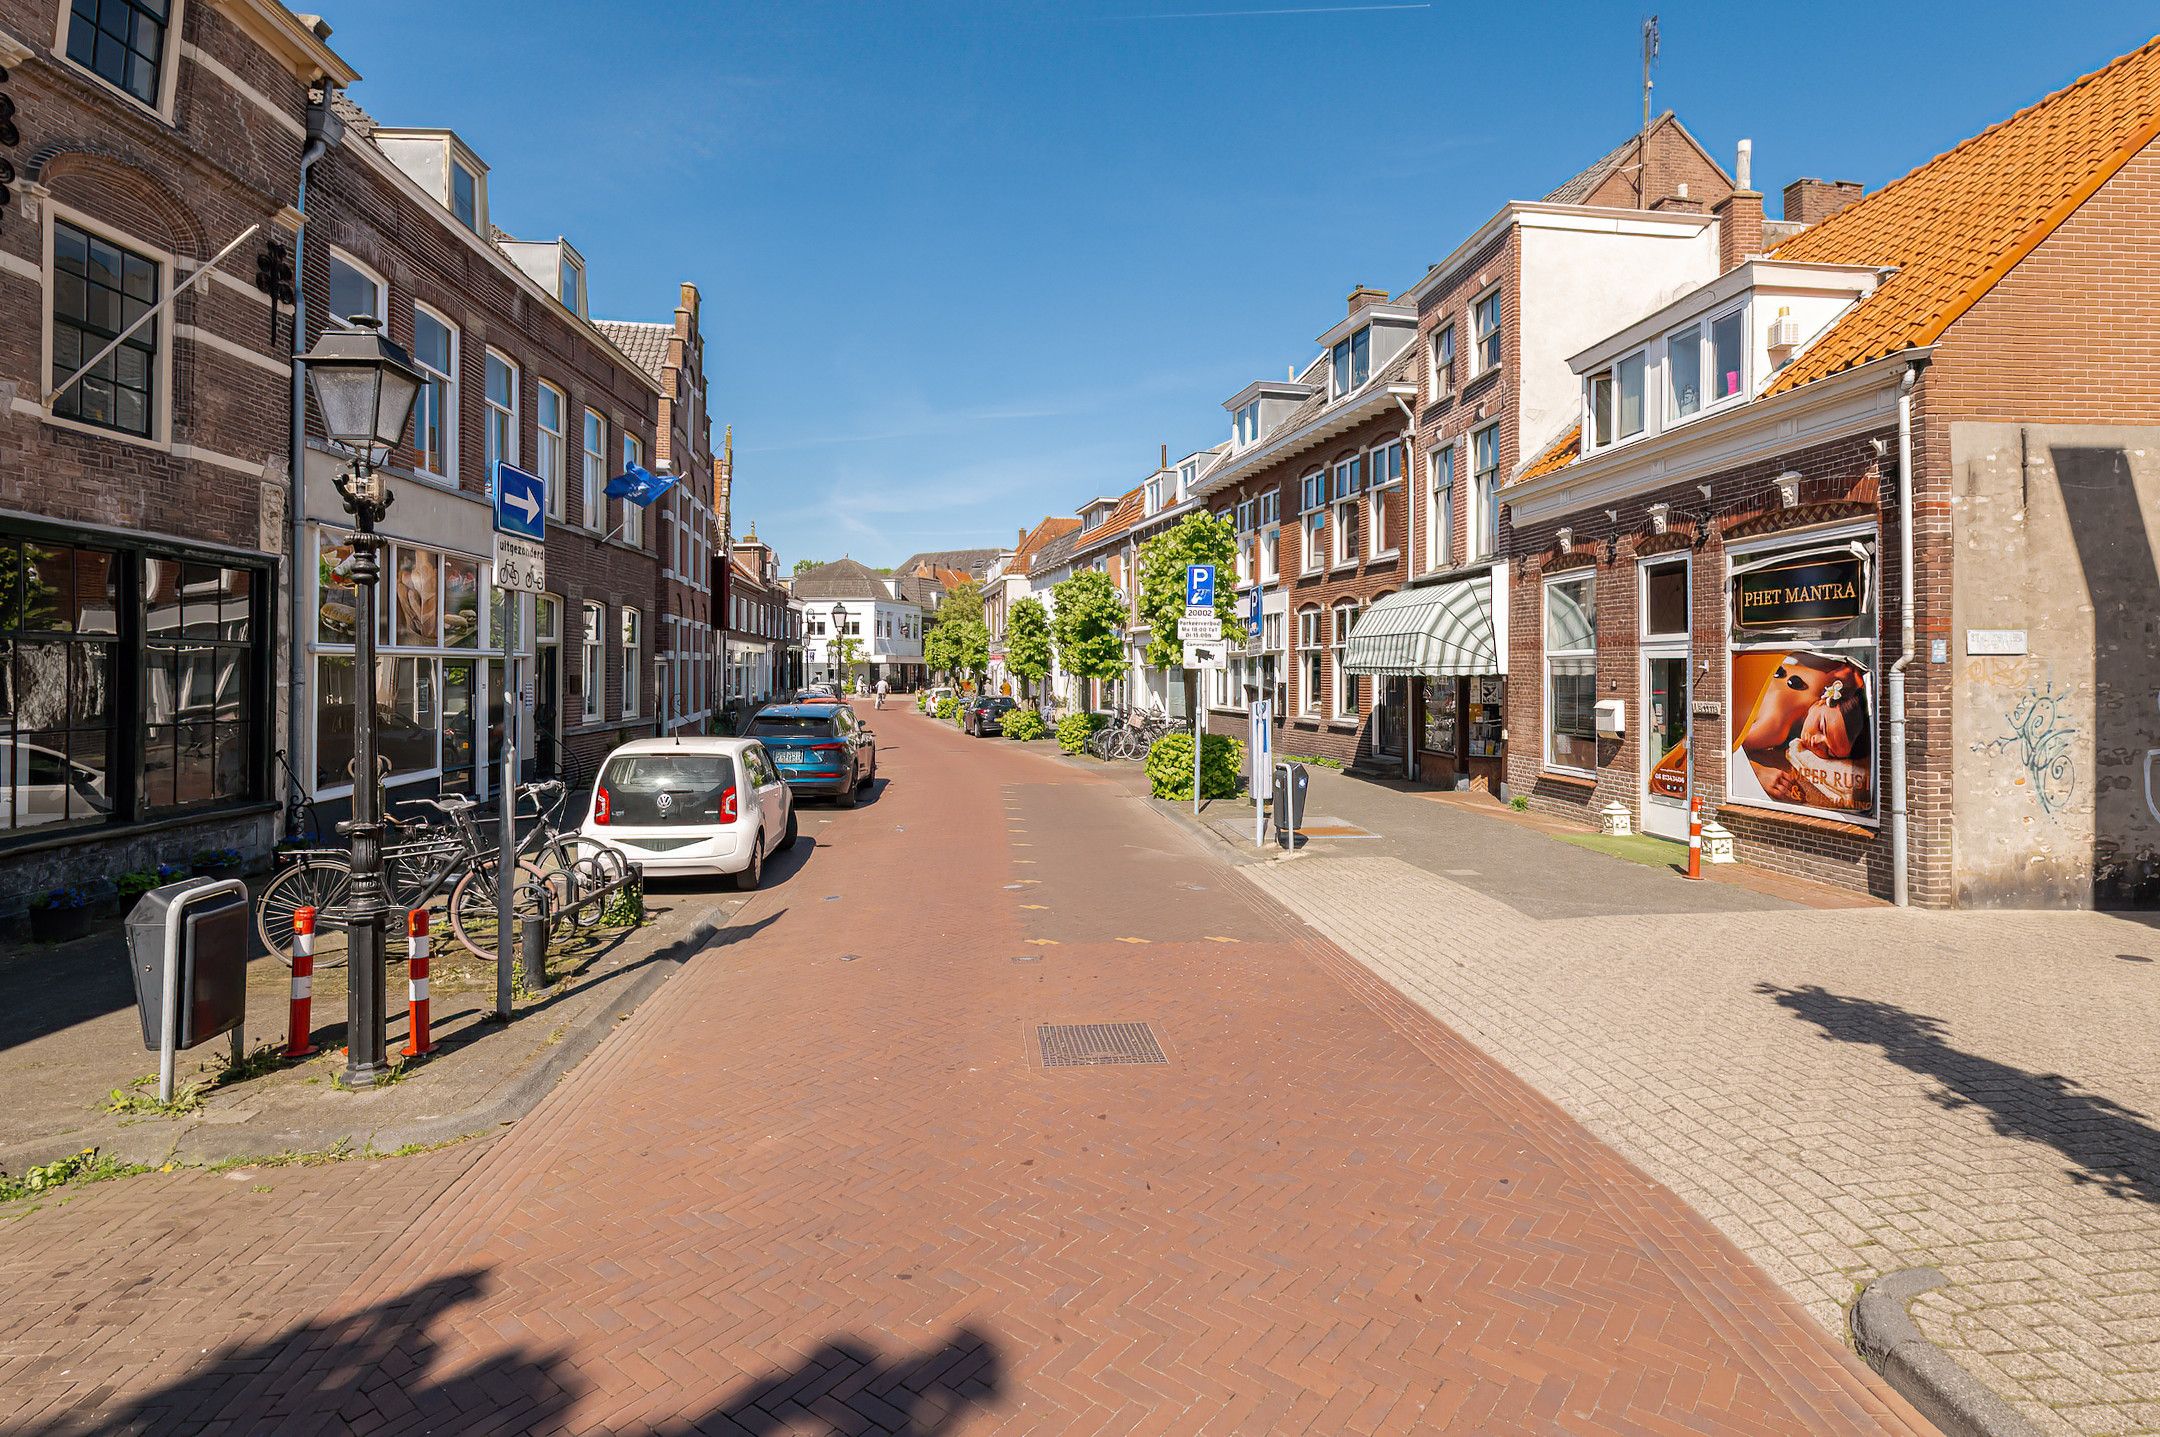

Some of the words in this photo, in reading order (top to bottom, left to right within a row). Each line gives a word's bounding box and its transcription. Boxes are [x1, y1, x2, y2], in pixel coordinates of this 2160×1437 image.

[500, 540, 544, 560] uitgezonderd
[1193, 568, 1208, 589] P
[1252, 591, 1257, 616] P
[1744, 589, 1782, 607] PHET
[1784, 581, 1856, 604] MANTRA
[1188, 609, 1212, 617] 20002
[1791, 785, 1802, 801] &
